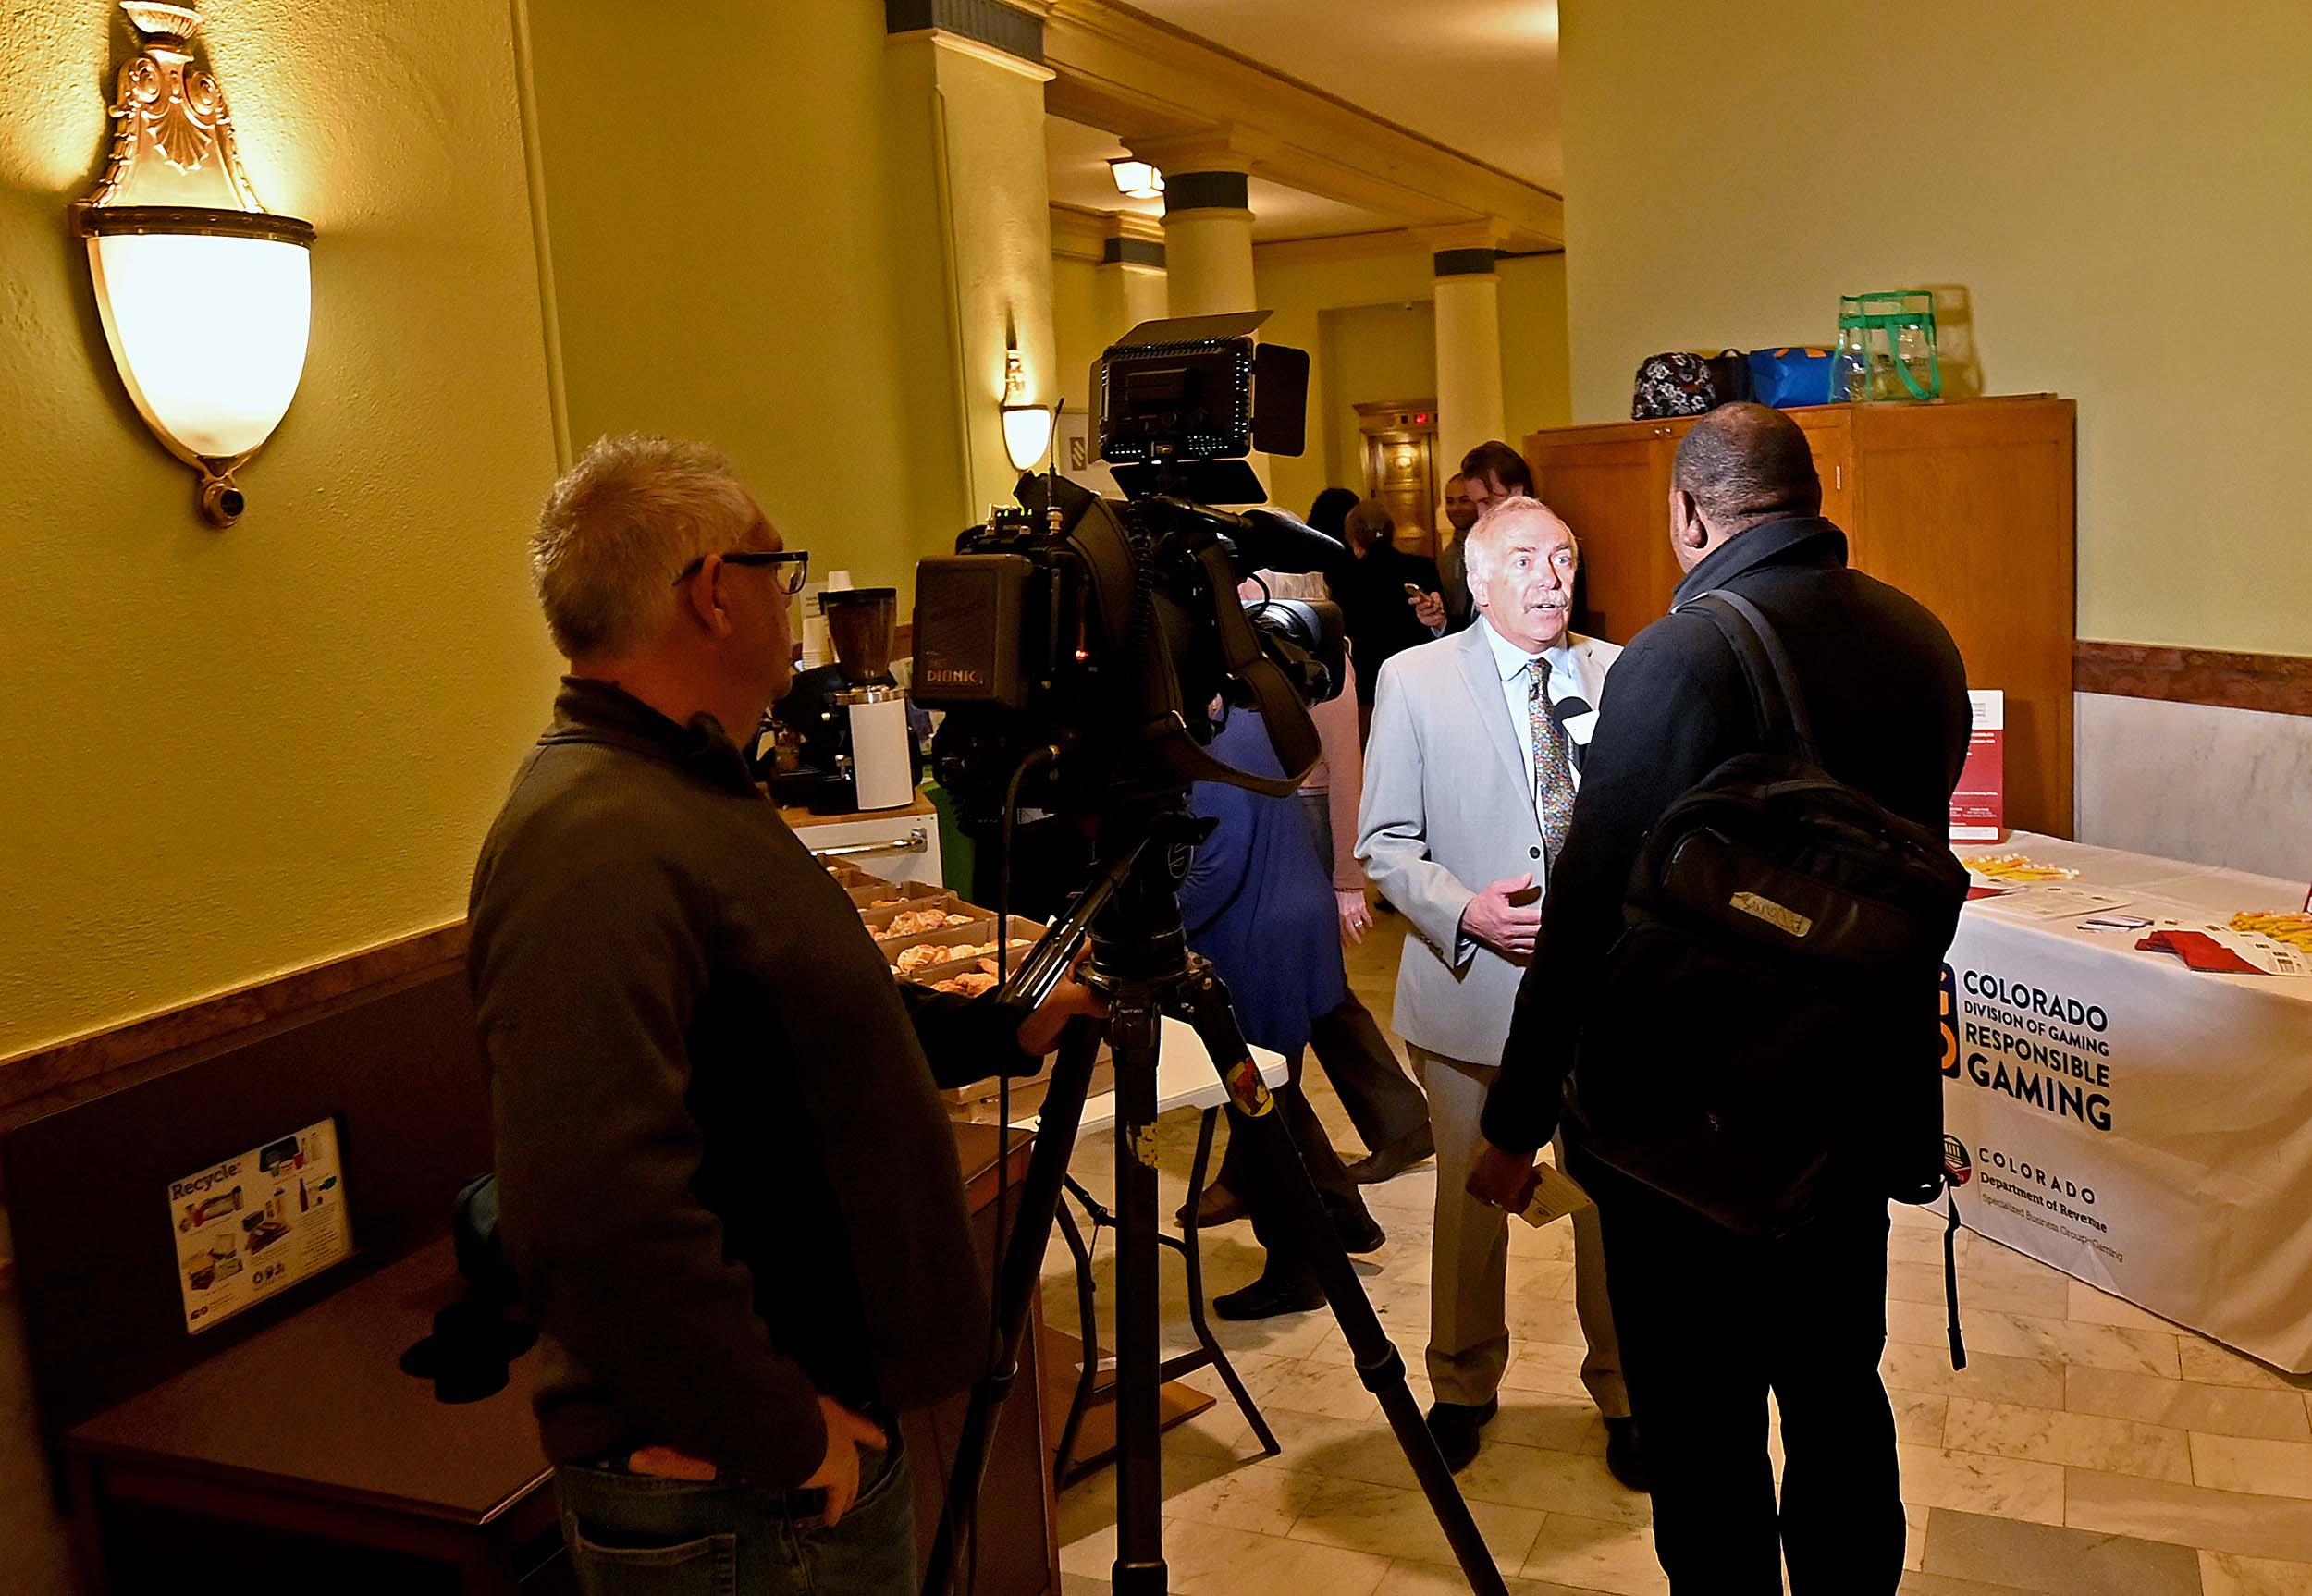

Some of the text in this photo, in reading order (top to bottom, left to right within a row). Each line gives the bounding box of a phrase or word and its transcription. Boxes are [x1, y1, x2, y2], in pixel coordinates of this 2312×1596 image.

[1964, 970, 2108, 1032] COLORADO
[1964, 1001, 2109, 1056] DIVISION OF GAMING
[1966, 1022, 2109, 1087] RESPONSIBLE
[1967, 1052, 2111, 1131] GAMING
[1979, 1148, 2095, 1204] COLORADO
[1980, 1172, 2108, 1234] Department of Revenue
